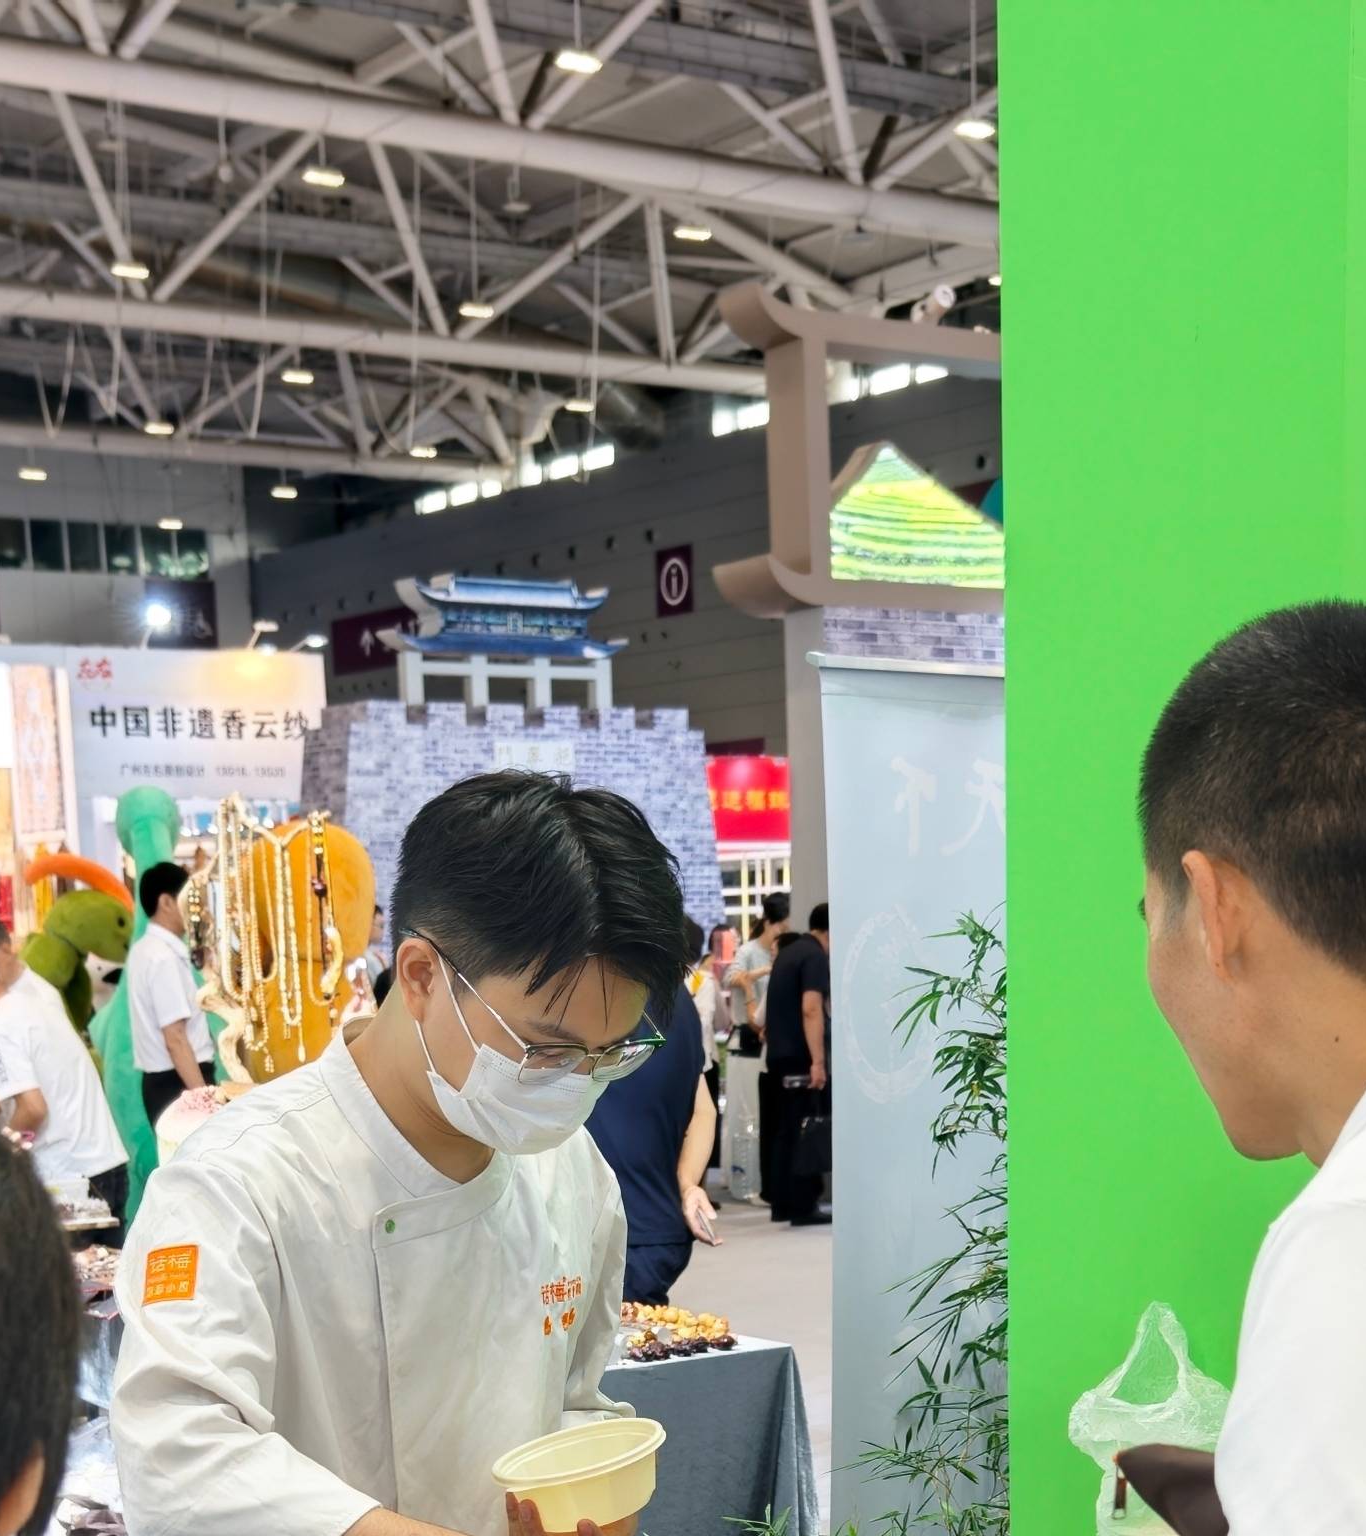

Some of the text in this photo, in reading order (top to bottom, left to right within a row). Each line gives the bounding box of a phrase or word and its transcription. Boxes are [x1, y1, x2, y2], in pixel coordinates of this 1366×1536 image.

[90, 704, 310, 741] 中国非遗香云纱
